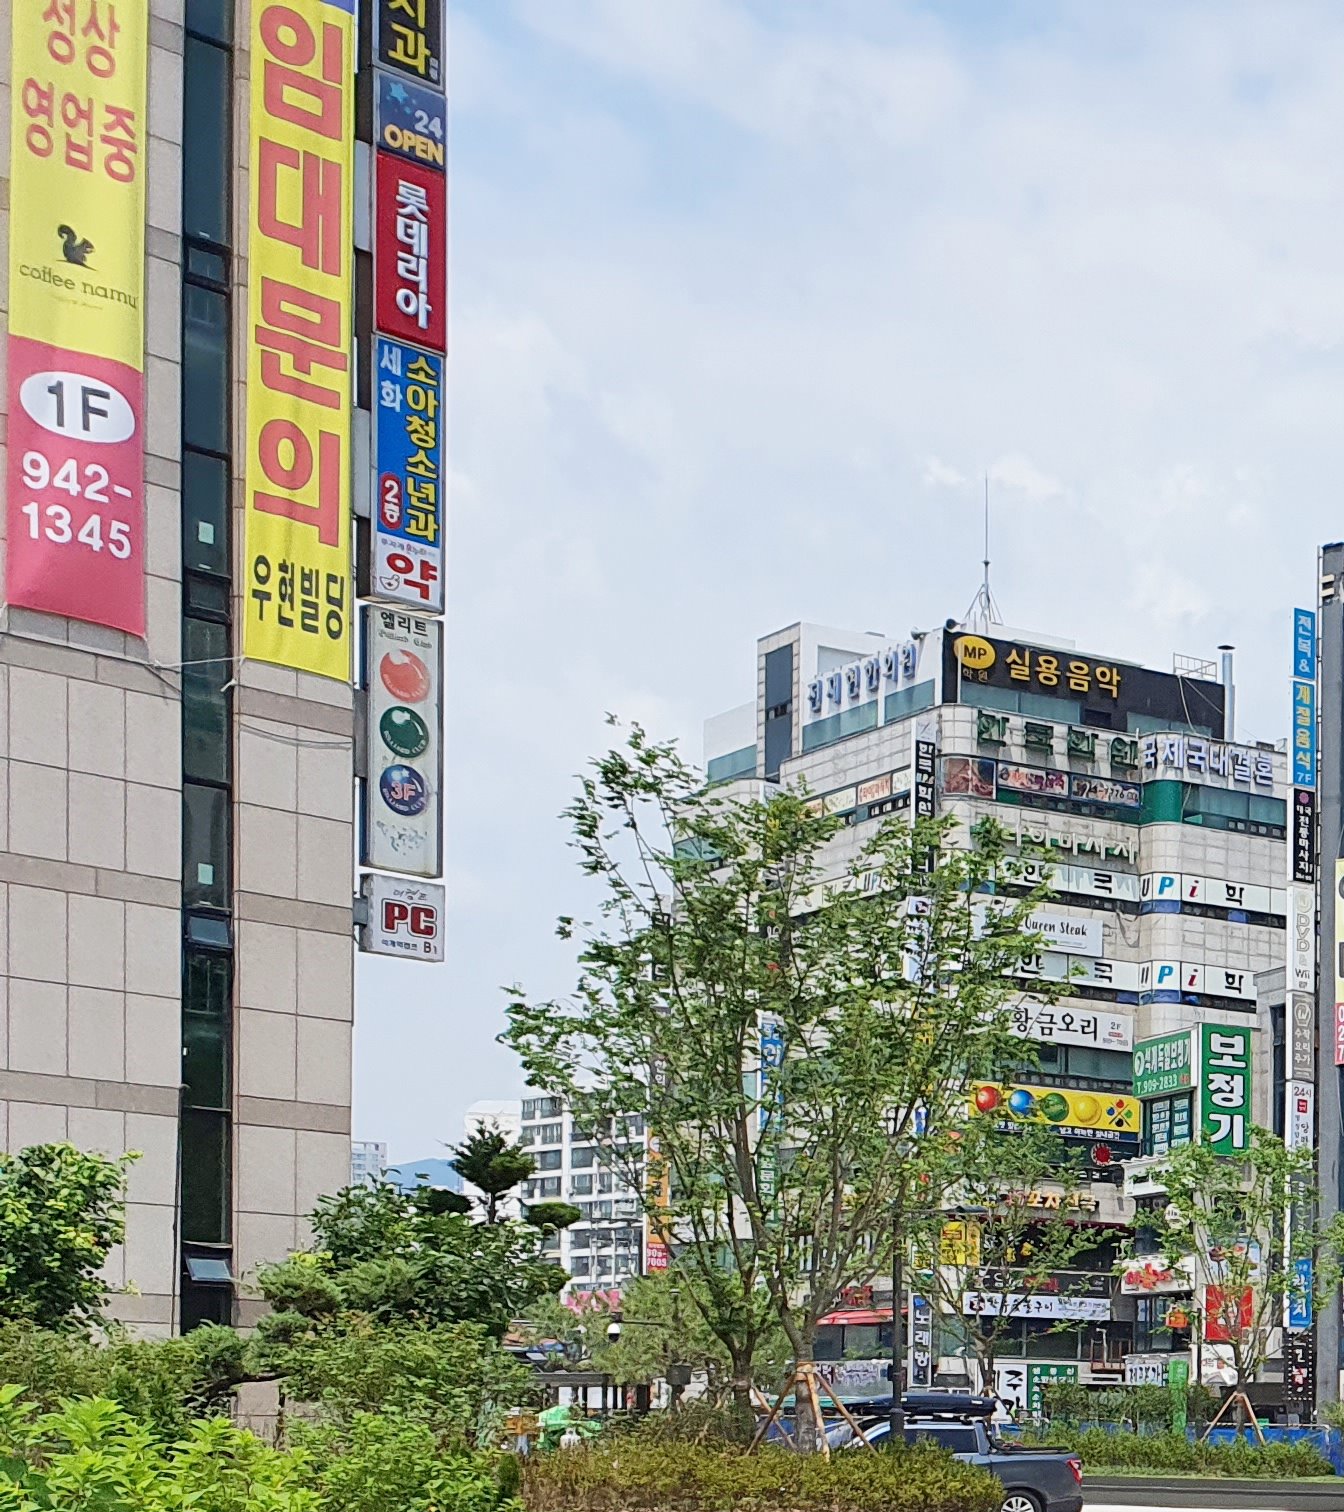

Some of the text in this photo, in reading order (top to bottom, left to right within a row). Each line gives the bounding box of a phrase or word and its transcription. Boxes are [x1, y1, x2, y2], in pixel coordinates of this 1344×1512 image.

[21, 76, 138, 184] 영업중
[384, 124, 444, 166] OPEN
[414, 109, 443, 139] 24
[254, 5, 348, 548] 임대문의
[395, 179, 433, 329] 롯데리아
[19, 262, 138, 311] coffee namu
[380, 344, 402, 413] 세화
[46, 380, 112, 433] 1F
[405, 355, 439, 543] 소아청소년과
[22, 450, 132, 504] 942-
[20, 501, 132, 559] 1345
[252, 554, 346, 640] 우현빌딩
[386, 552, 438, 601] 약
[963, 645, 988, 661] MP
[1005, 648, 1122, 699] 실용음악
[391, 781, 416, 801] 3F
[382, 899, 437, 939] PC
[1059, 918, 1089, 937] Steak
[1011, 1006, 1099, 1042] 황금오리
[914, 1308, 930, 1368] 노래방
